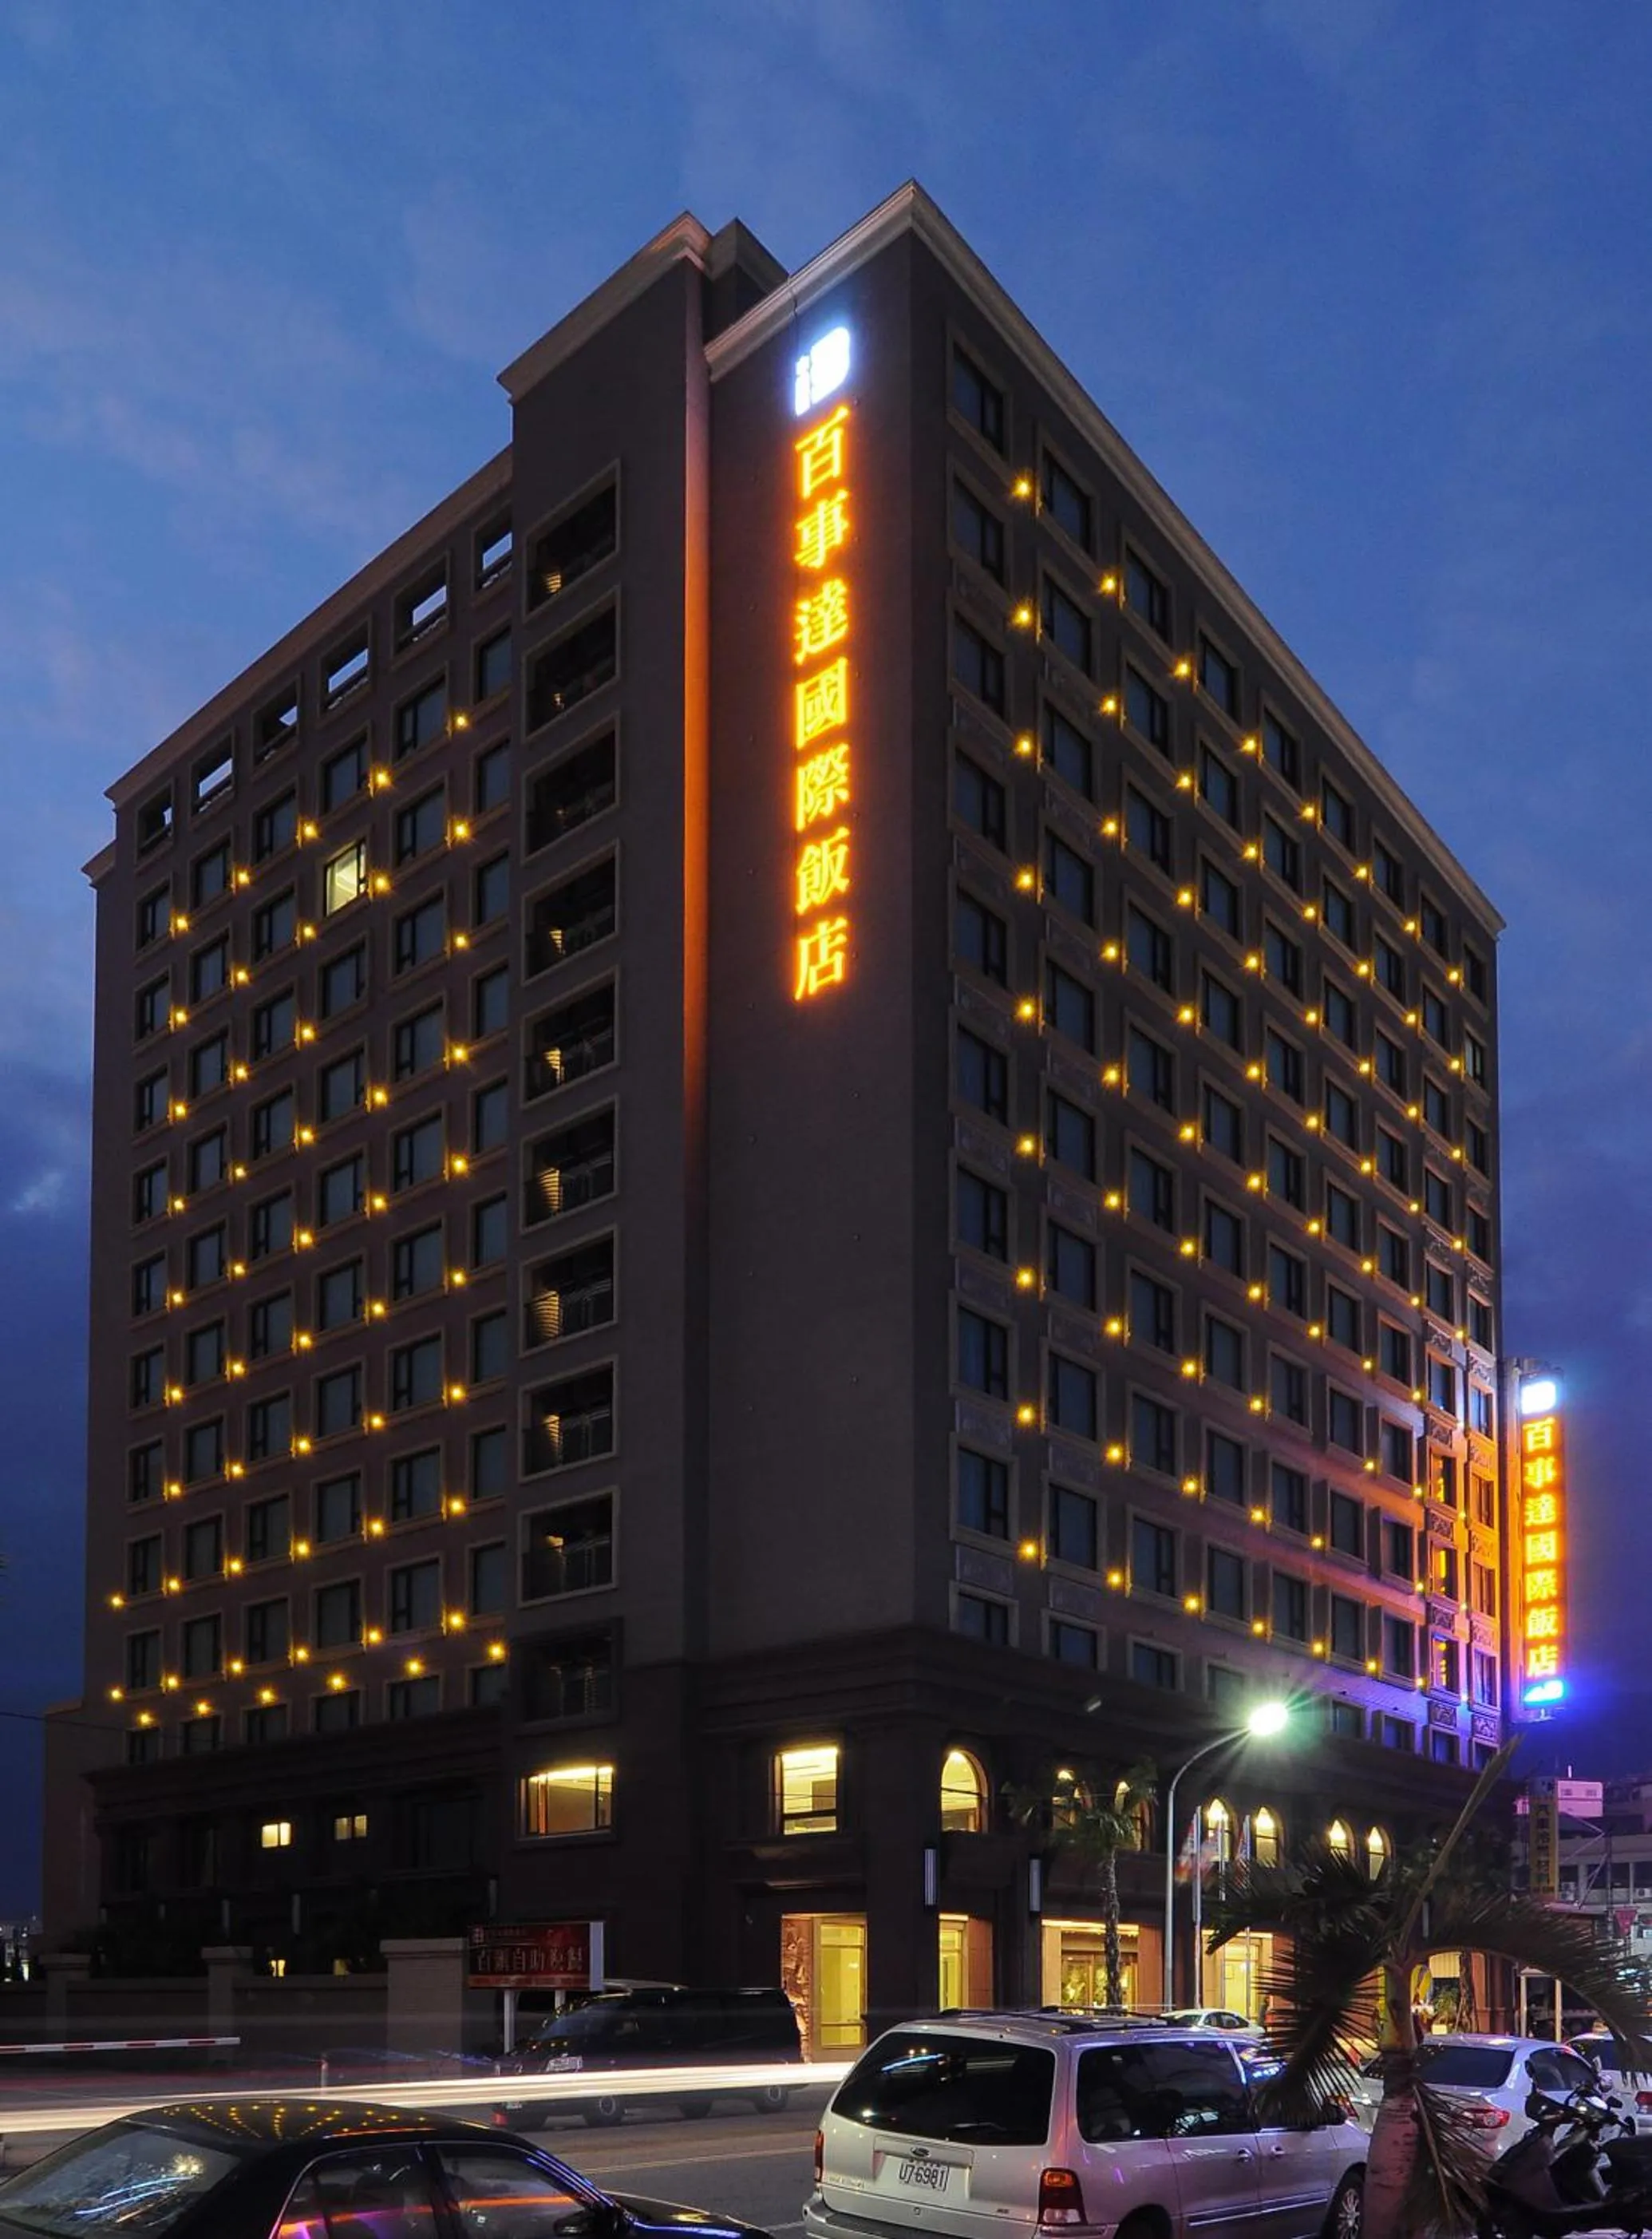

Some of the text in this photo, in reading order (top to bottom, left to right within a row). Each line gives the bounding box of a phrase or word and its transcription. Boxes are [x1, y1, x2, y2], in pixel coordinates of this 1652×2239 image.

[794, 405, 849, 1000] 百事達國際飯店
[1523, 1417, 1559, 1677] 百事達國際飯店
